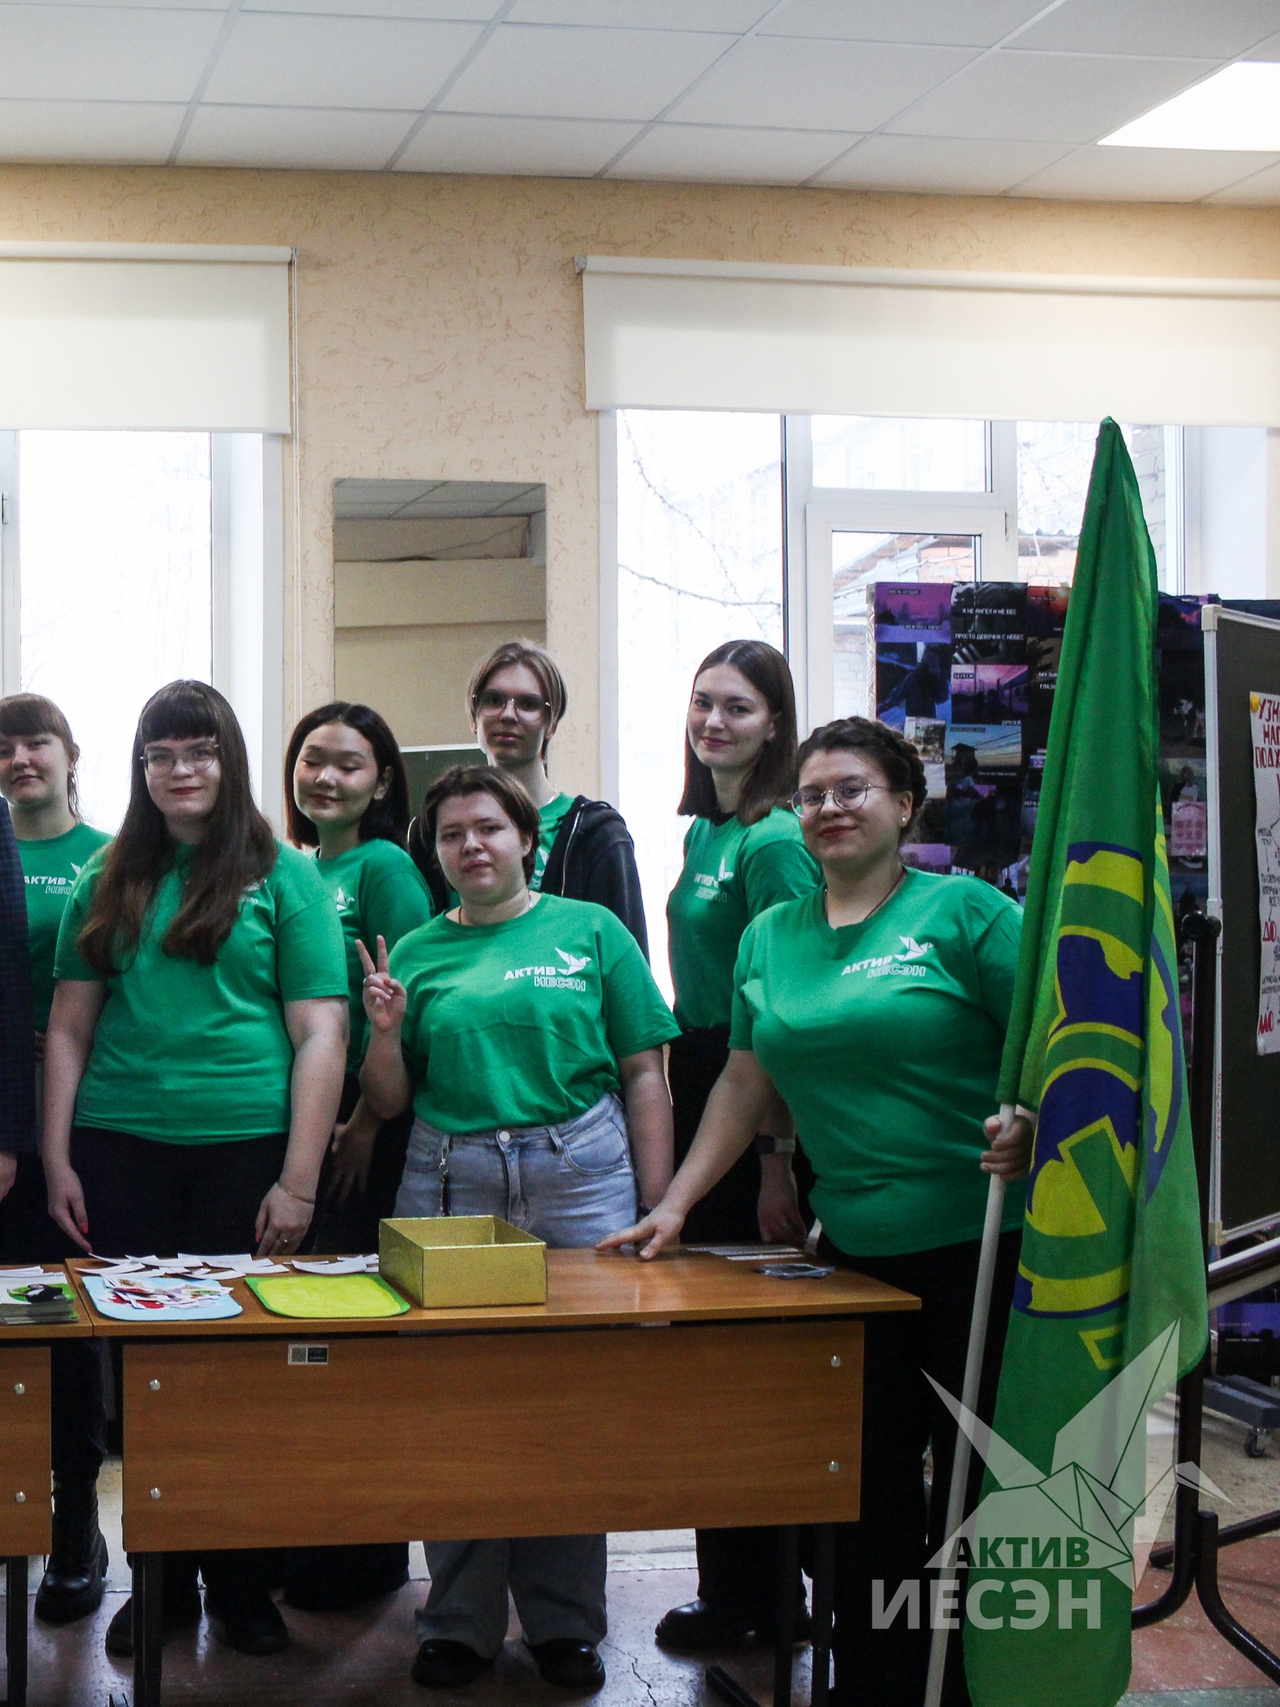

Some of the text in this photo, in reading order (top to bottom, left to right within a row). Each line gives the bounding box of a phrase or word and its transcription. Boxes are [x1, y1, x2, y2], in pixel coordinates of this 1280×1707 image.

[503, 966, 557, 981] АКТИВ
[841, 955, 894, 976] АКТИВ
[866, 963, 927, 979] ИЕСЭН
[534, 976, 586, 992] ИЕСЭН
